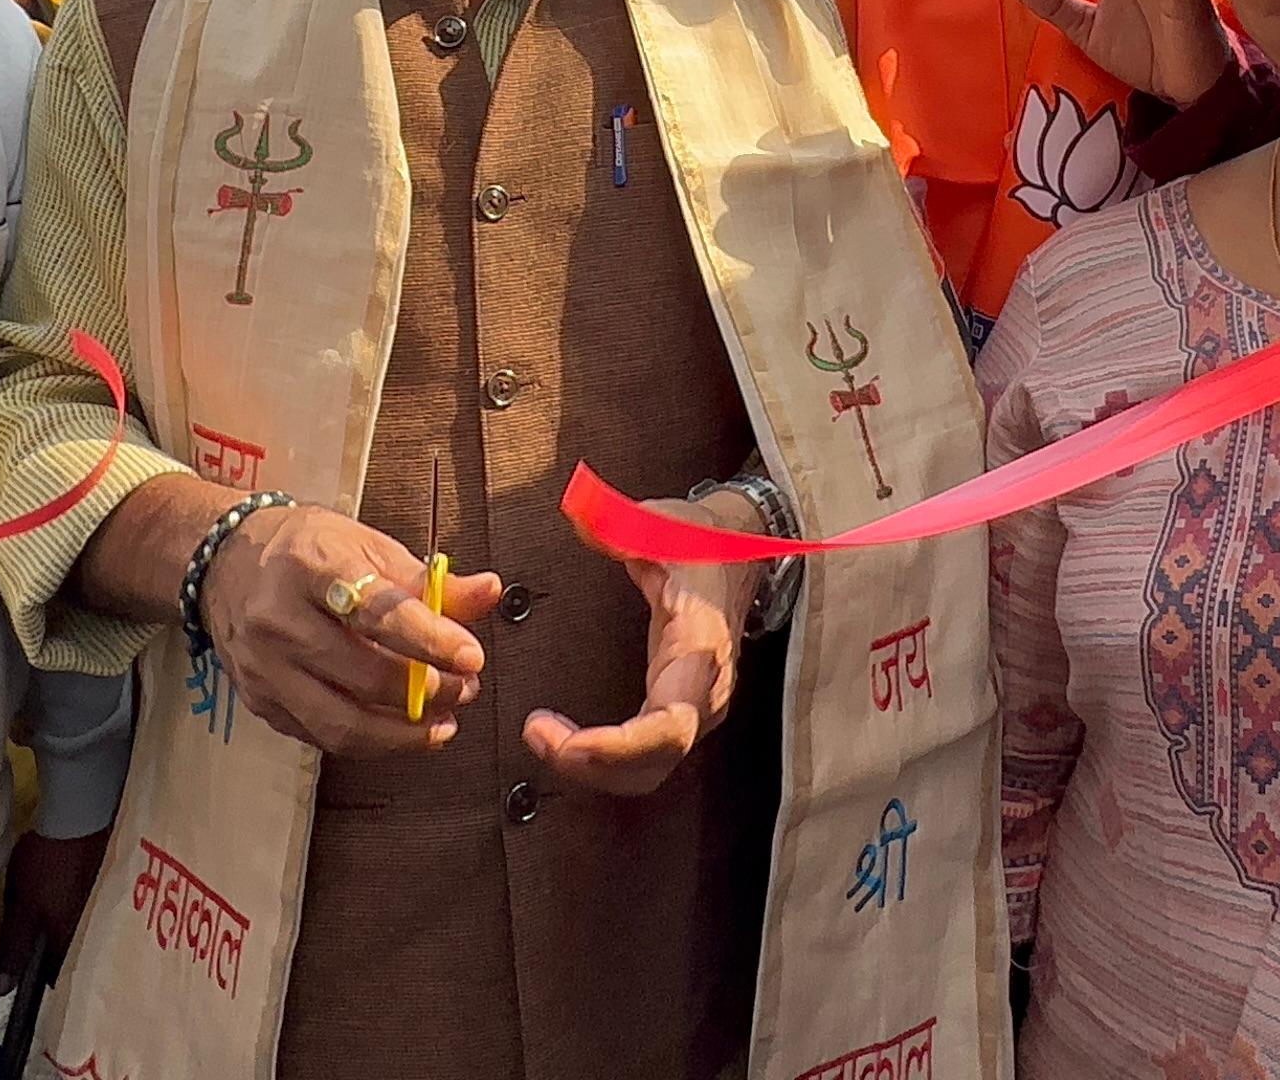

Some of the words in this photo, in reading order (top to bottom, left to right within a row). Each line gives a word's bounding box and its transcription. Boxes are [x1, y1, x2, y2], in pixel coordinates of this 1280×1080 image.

[870, 616, 933, 712] जय
[846, 797, 918, 913] श्री
[131, 835, 251, 1001] महाकाल
